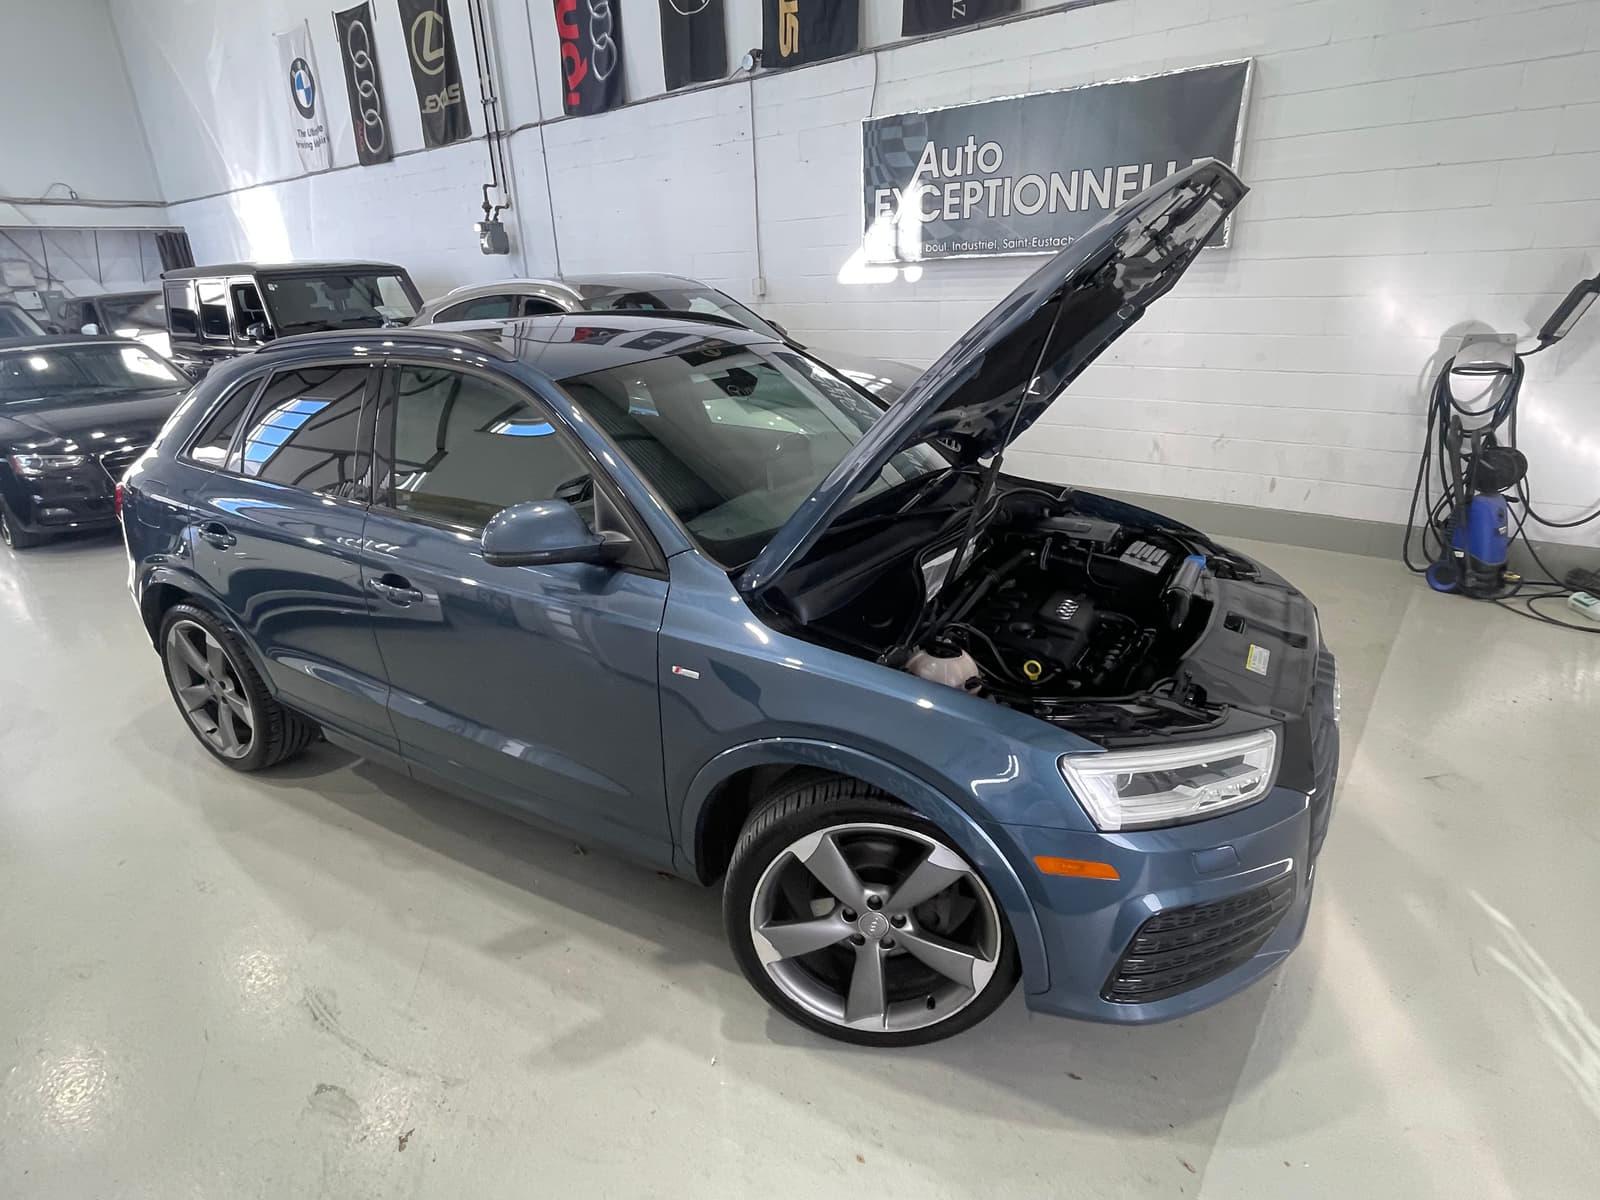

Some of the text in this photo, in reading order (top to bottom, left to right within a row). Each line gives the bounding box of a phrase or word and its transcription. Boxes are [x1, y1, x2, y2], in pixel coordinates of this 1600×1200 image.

[912, 135, 1003, 185] Auto
[925, 241, 949, 253] boul.
[952, 239, 1000, 251] Industriel,
